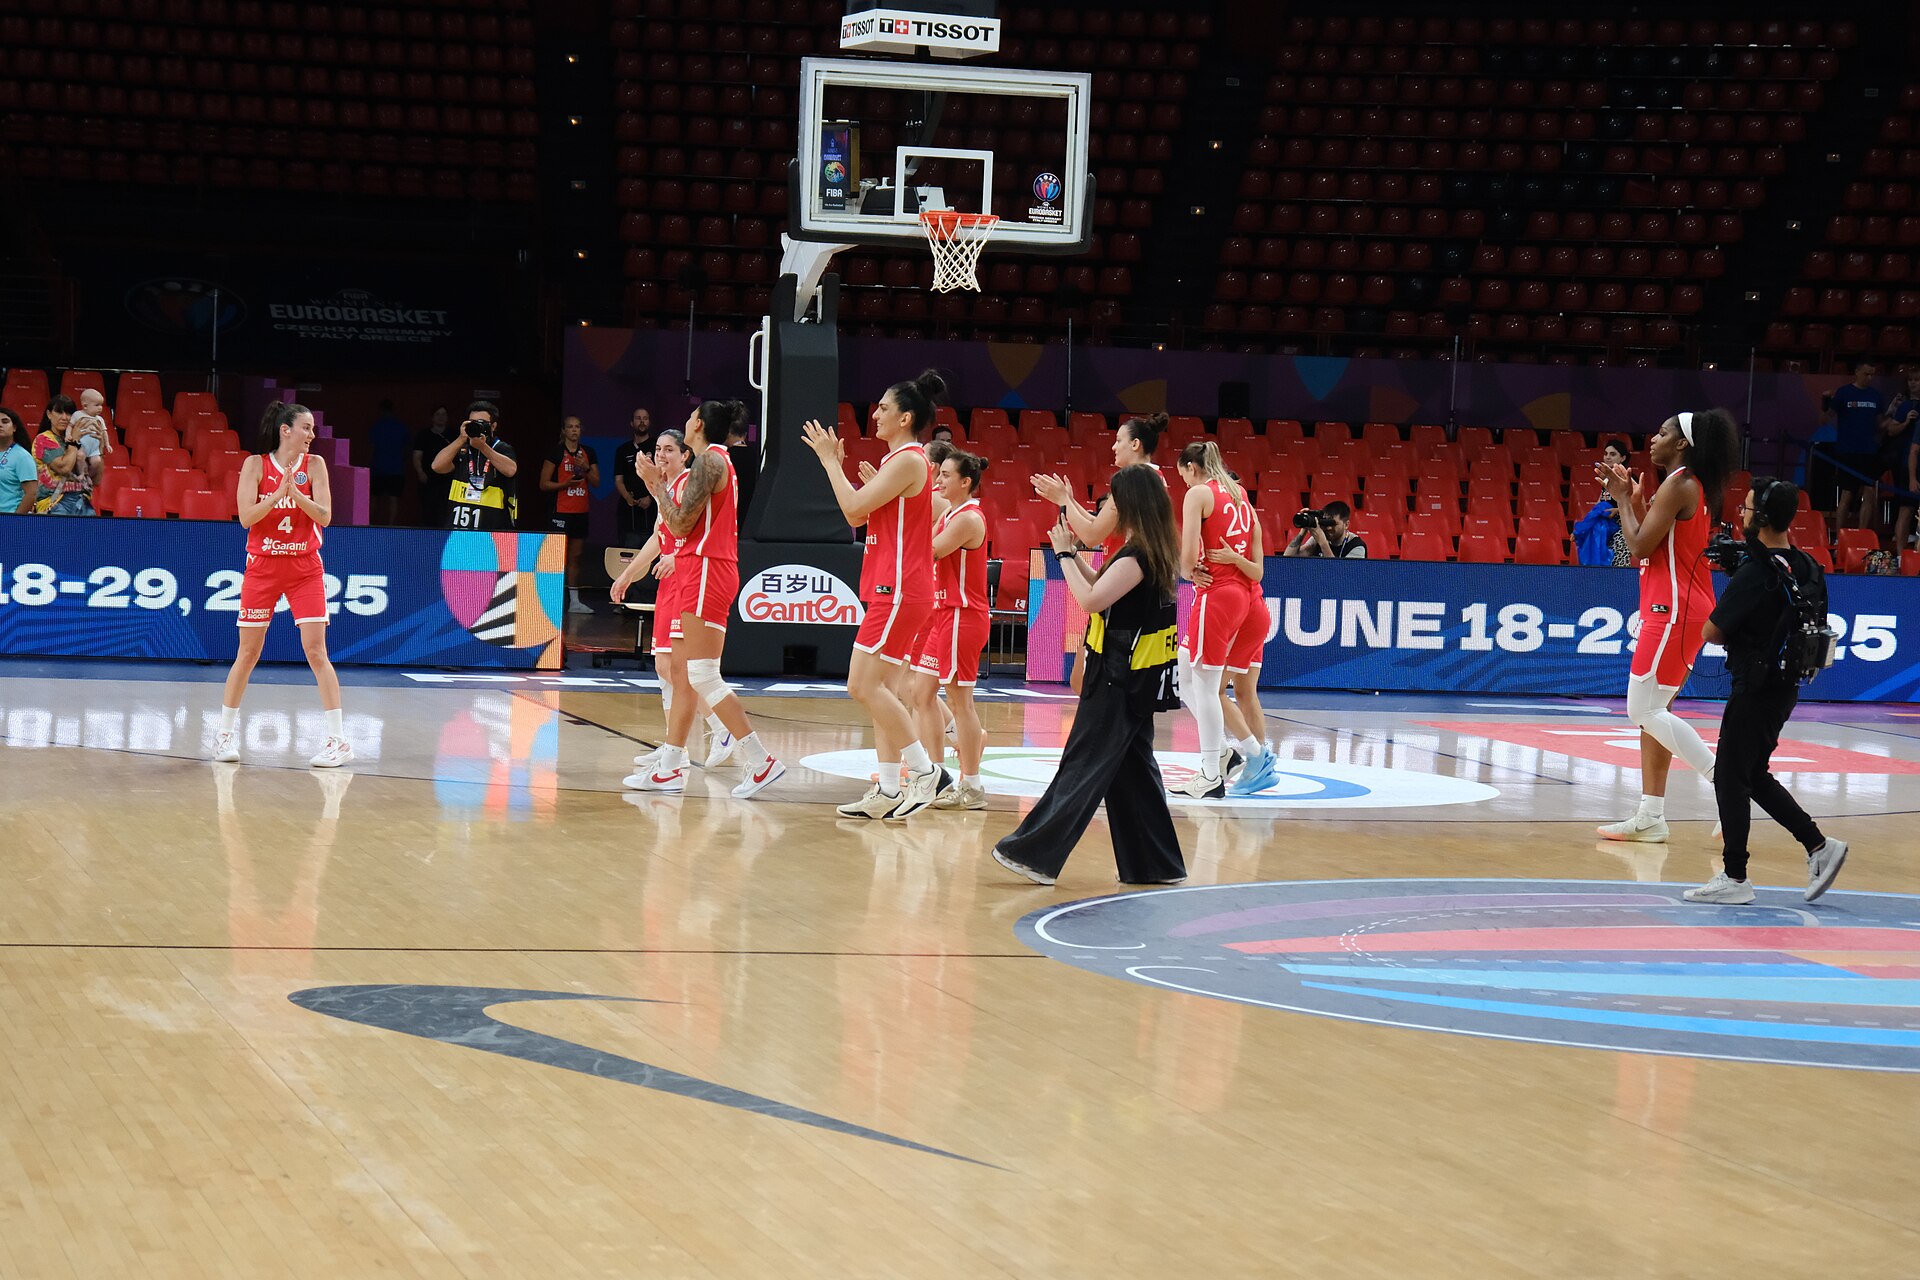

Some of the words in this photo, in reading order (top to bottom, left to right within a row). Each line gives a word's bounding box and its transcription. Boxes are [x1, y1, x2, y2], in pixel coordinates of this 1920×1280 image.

[851, 18, 875, 37] TISSOT
[912, 20, 995, 42] TISSOT
[826, 188, 843, 198] FIBA
[269, 303, 448, 325] EUROBASKET
[272, 323, 360, 333] CZECHIA
[363, 327, 452, 337] GERMANY
[299, 331, 356, 340] ITALY
[358, 334, 433, 343] GREECE
[277, 516, 293, 533] 4
[452, 505, 481, 528] 151
[1223, 501, 1251, 537] 20
[271, 540, 308, 551] Garanti
[761, 573, 833, 594] 百岁山
